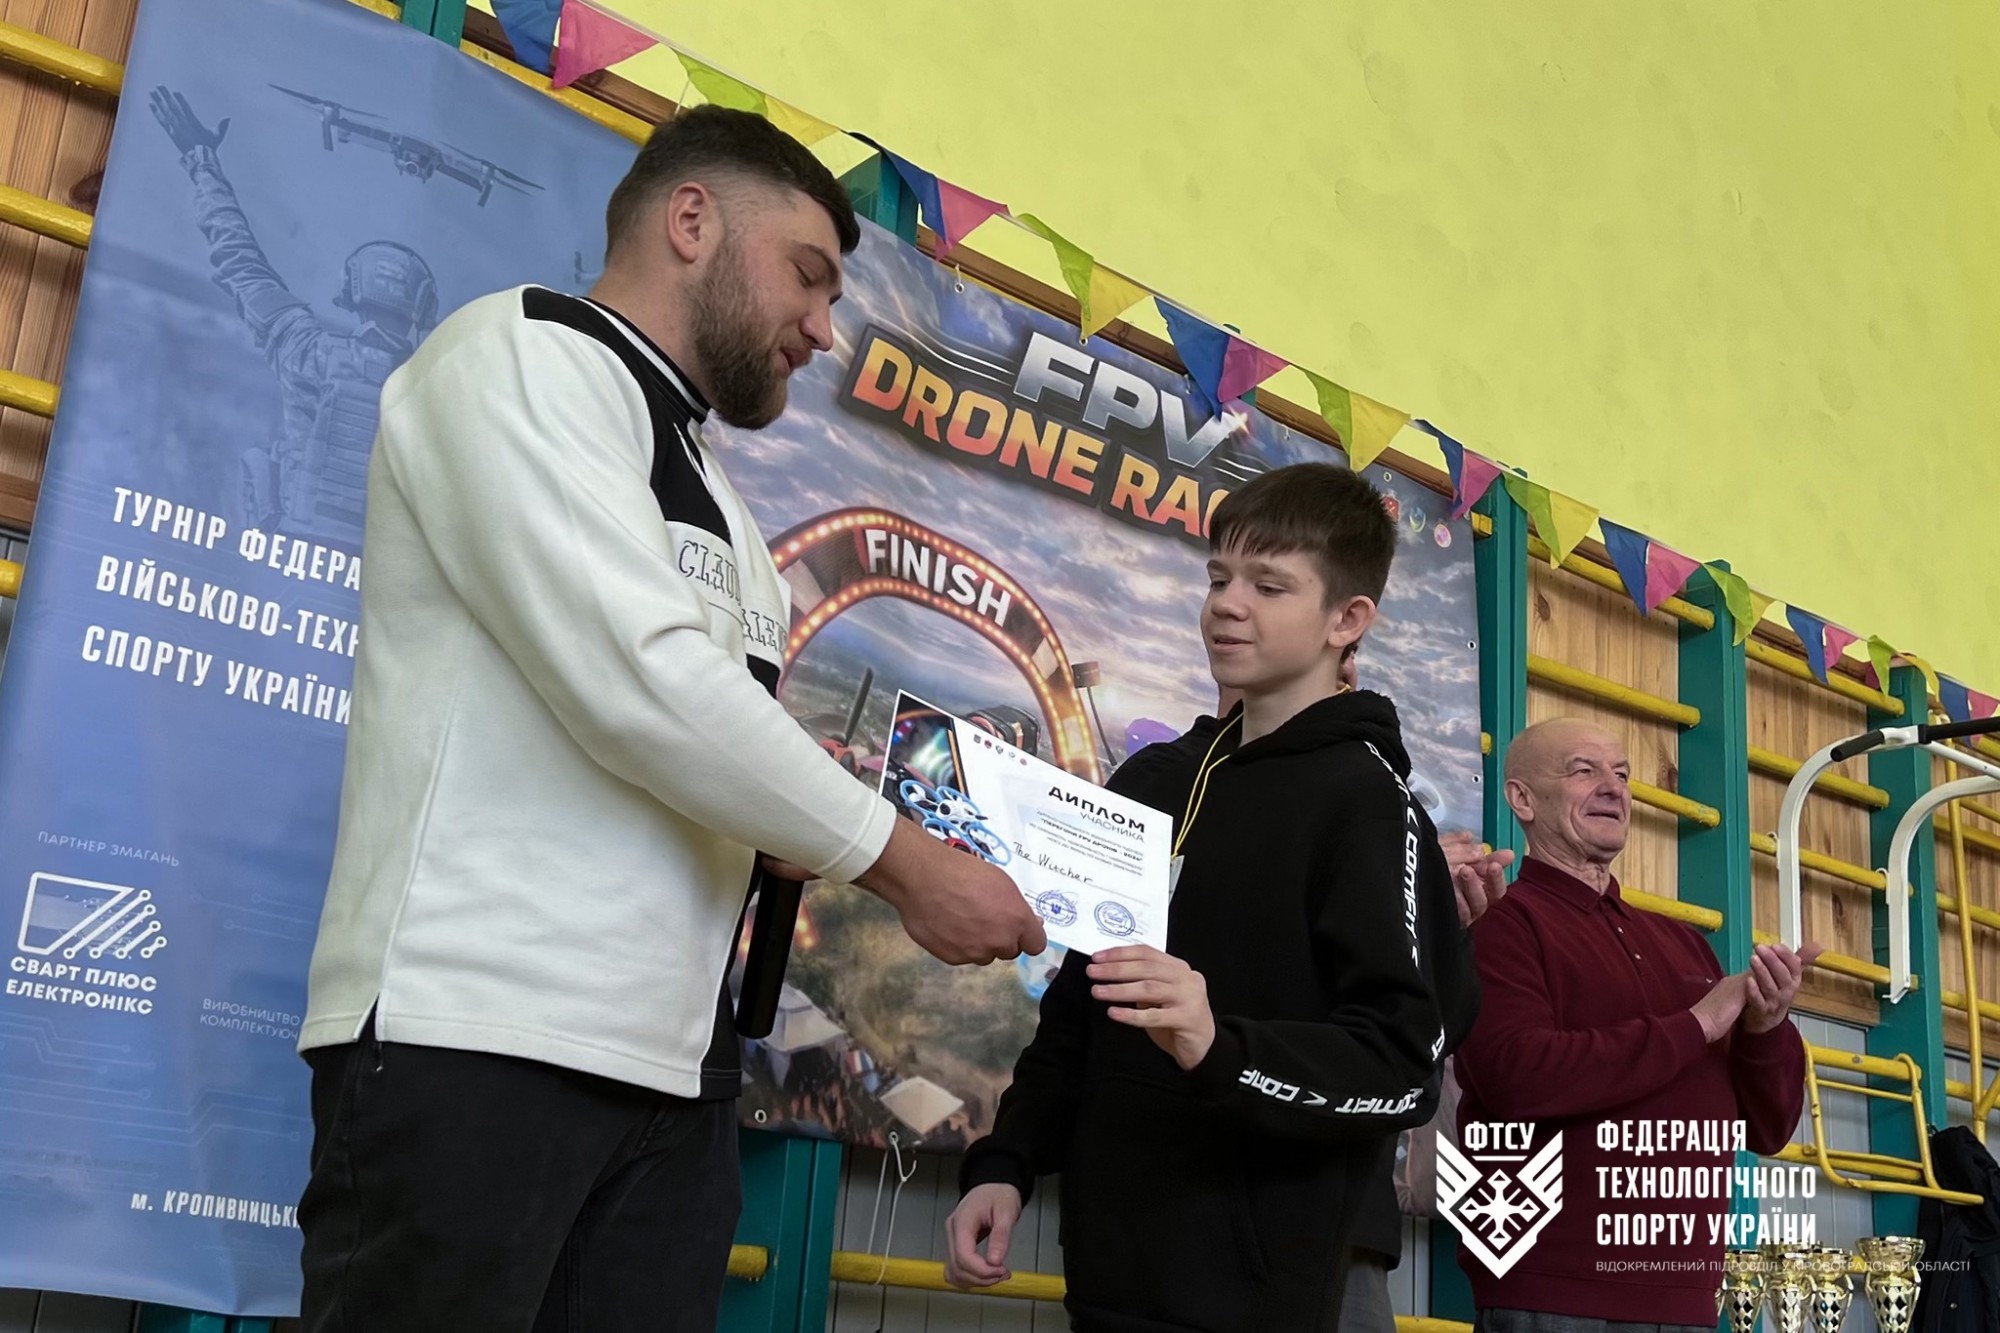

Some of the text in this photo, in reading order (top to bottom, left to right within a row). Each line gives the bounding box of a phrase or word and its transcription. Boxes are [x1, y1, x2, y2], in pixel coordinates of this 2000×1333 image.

[852, 337, 1105, 496] DRONE
[1013, 331, 1242, 468] FPV
[113, 486, 362, 592] ТУРНІР ФЕДЕРА
[864, 528, 1012, 628] FINISH
[82, 625, 352, 725] СПОРТУ УКРАЇНИ
[1048, 785, 1145, 833] ДИПЛОМ
[1080, 811, 1144, 844] УЧАСНИКА
[38, 831, 180, 868] ПАРТНЕР ЗМАГАНЬ
[1012, 841, 1032, 862] The
[1403, 831, 1419, 939] COMFIT
[10, 956, 158, 992] СВАРТ ПЛЮС
[5, 978, 154, 1016] ЕЛЕКТРОНІКС
[203, 998, 301, 1027] ВИРОБНИЦТВО
[200, 1013, 299, 1040] КОМПЛЕКТУЮЧ
[130, 1193, 153, 1211] м.
